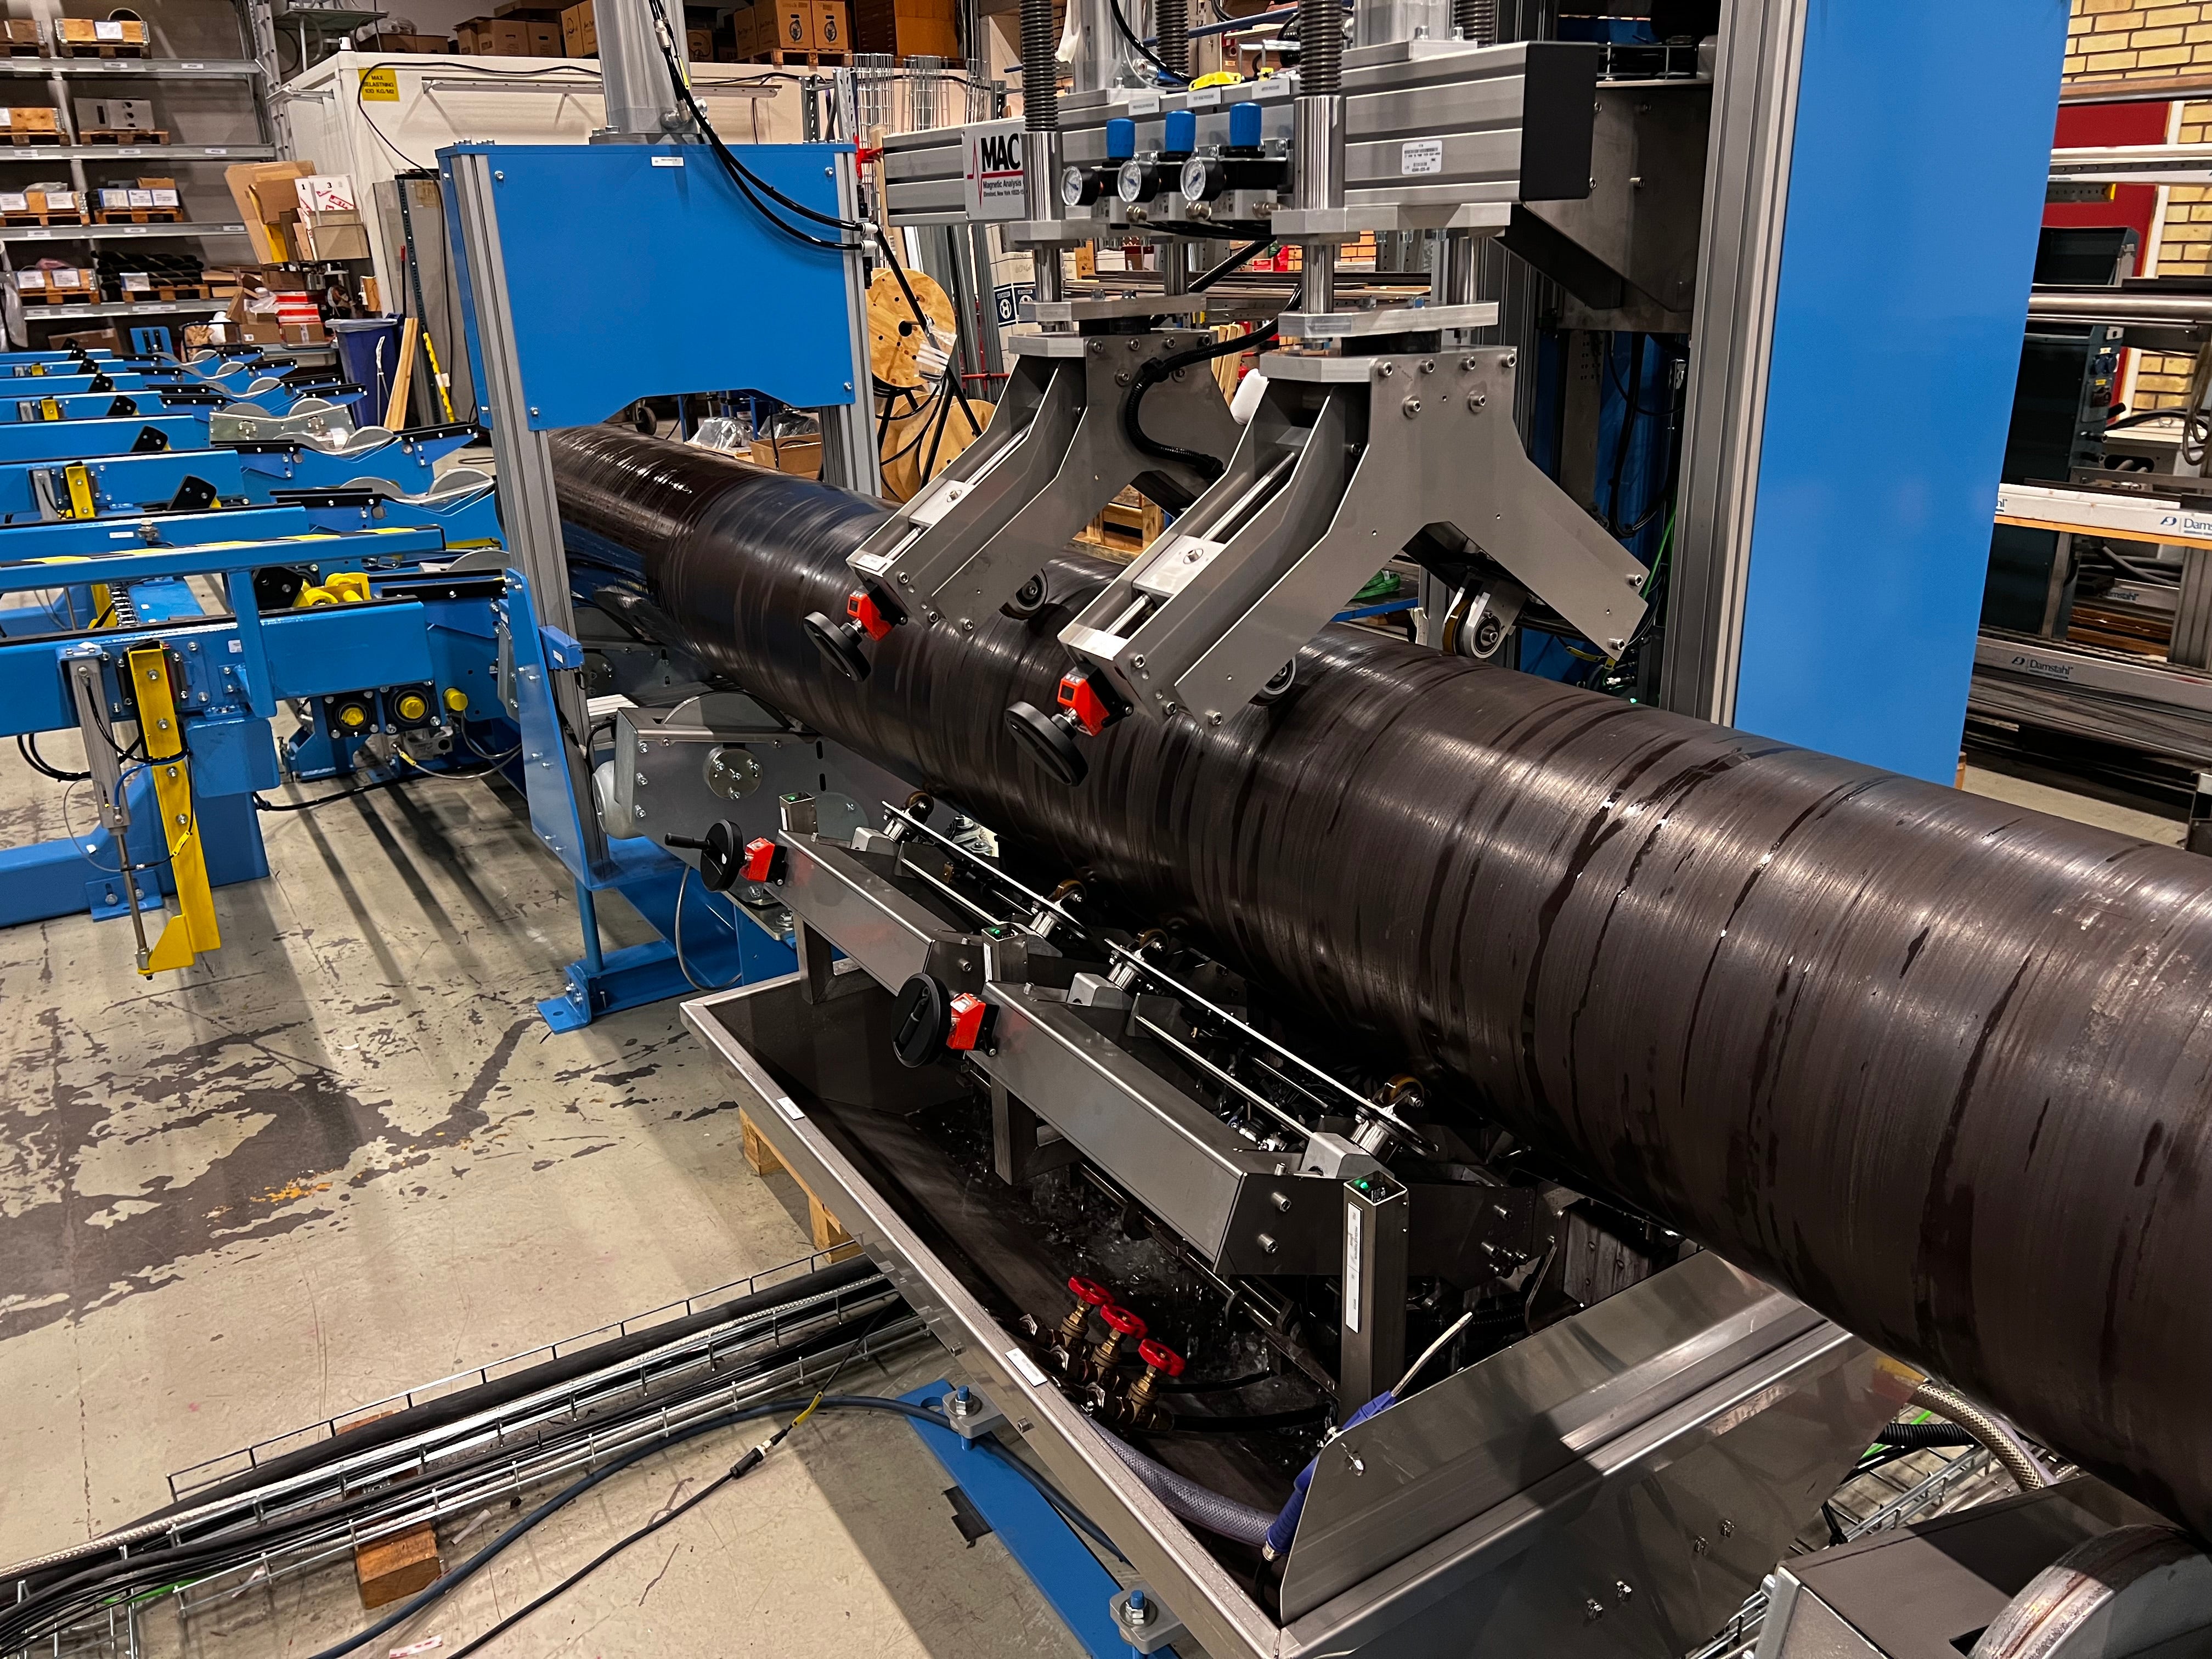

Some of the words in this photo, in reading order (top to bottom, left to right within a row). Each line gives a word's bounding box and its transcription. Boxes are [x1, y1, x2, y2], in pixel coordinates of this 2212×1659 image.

[981, 133, 1021, 172] MAC
[983, 180, 1002, 190] Magnetic
[1003, 178, 1022, 189] Analysis
[2030, 659, 2070, 675] Damstahl
